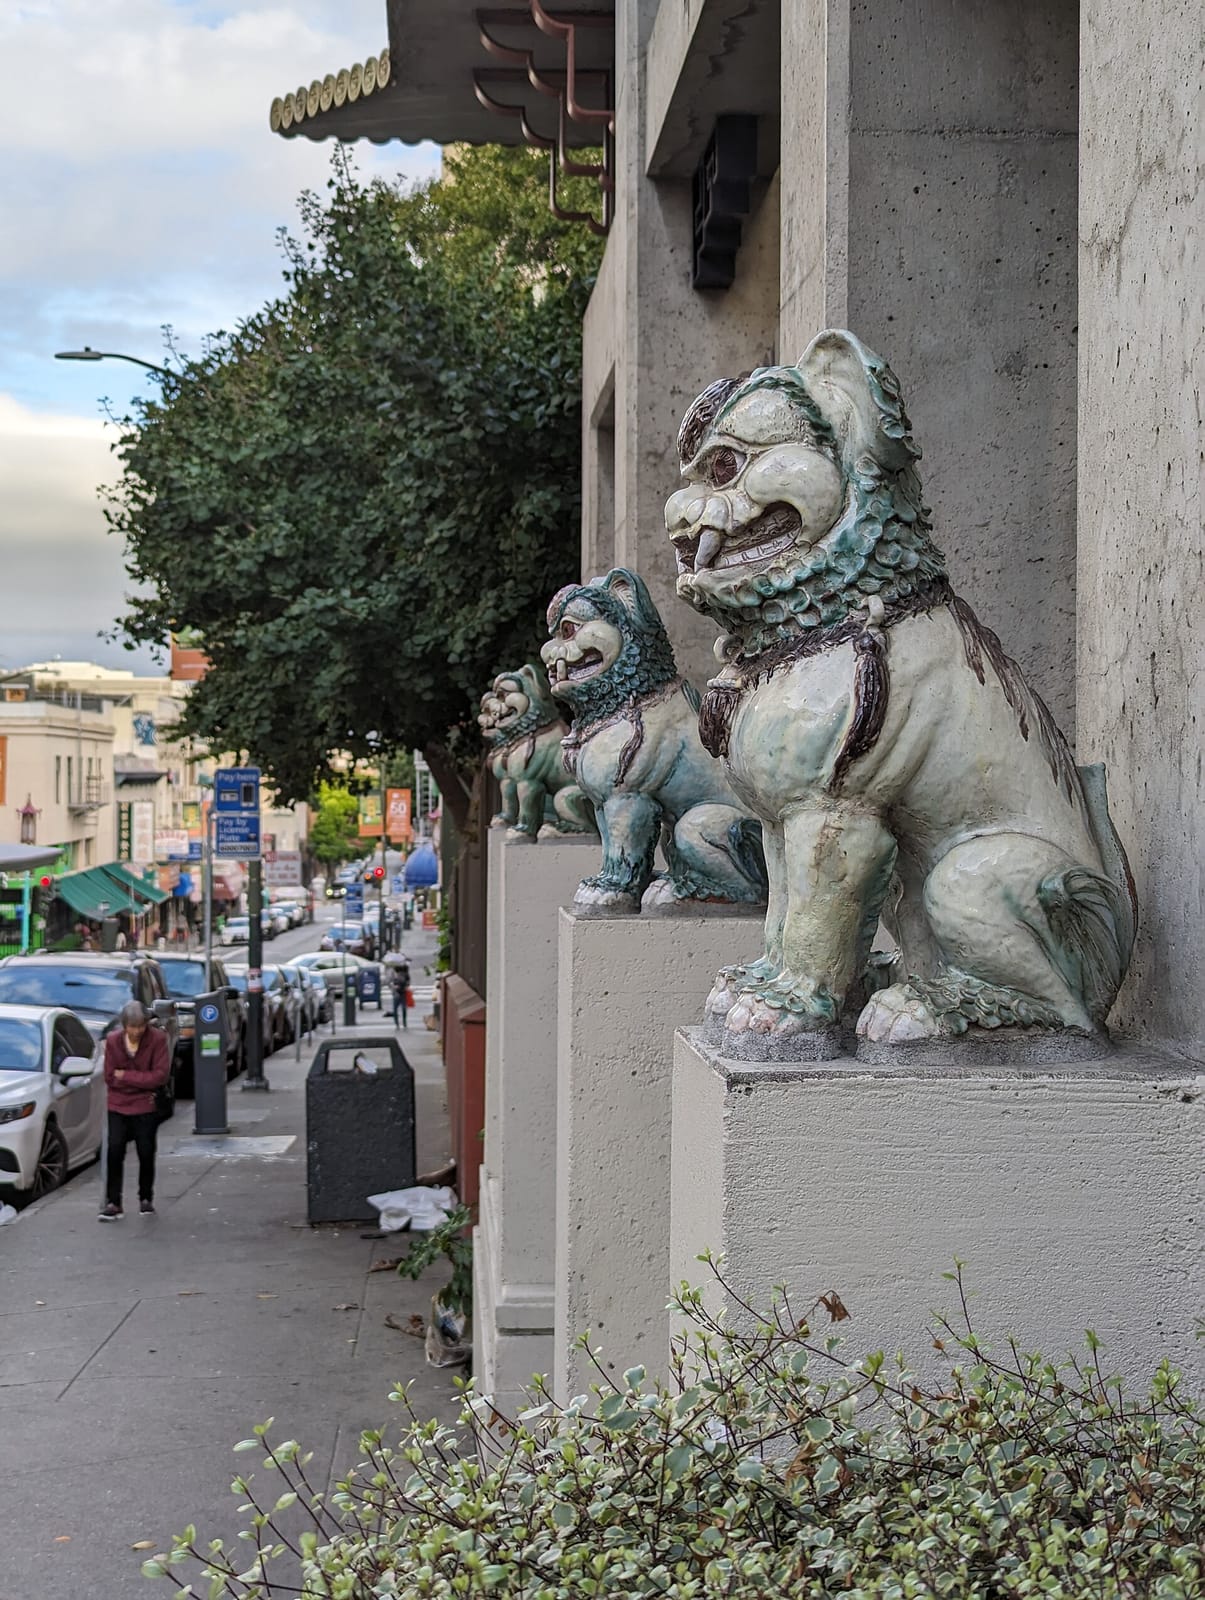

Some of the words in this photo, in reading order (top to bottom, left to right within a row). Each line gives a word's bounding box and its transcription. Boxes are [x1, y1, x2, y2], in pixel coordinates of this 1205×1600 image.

[219, 772, 235, 783] Pay
[237, 772, 258, 781] here
[390, 802, 407, 816] 50
[219, 817, 234, 827] Pay
[236, 817, 248, 826] by
[219, 826, 250, 834] License
[219, 834, 241, 842] Plate
